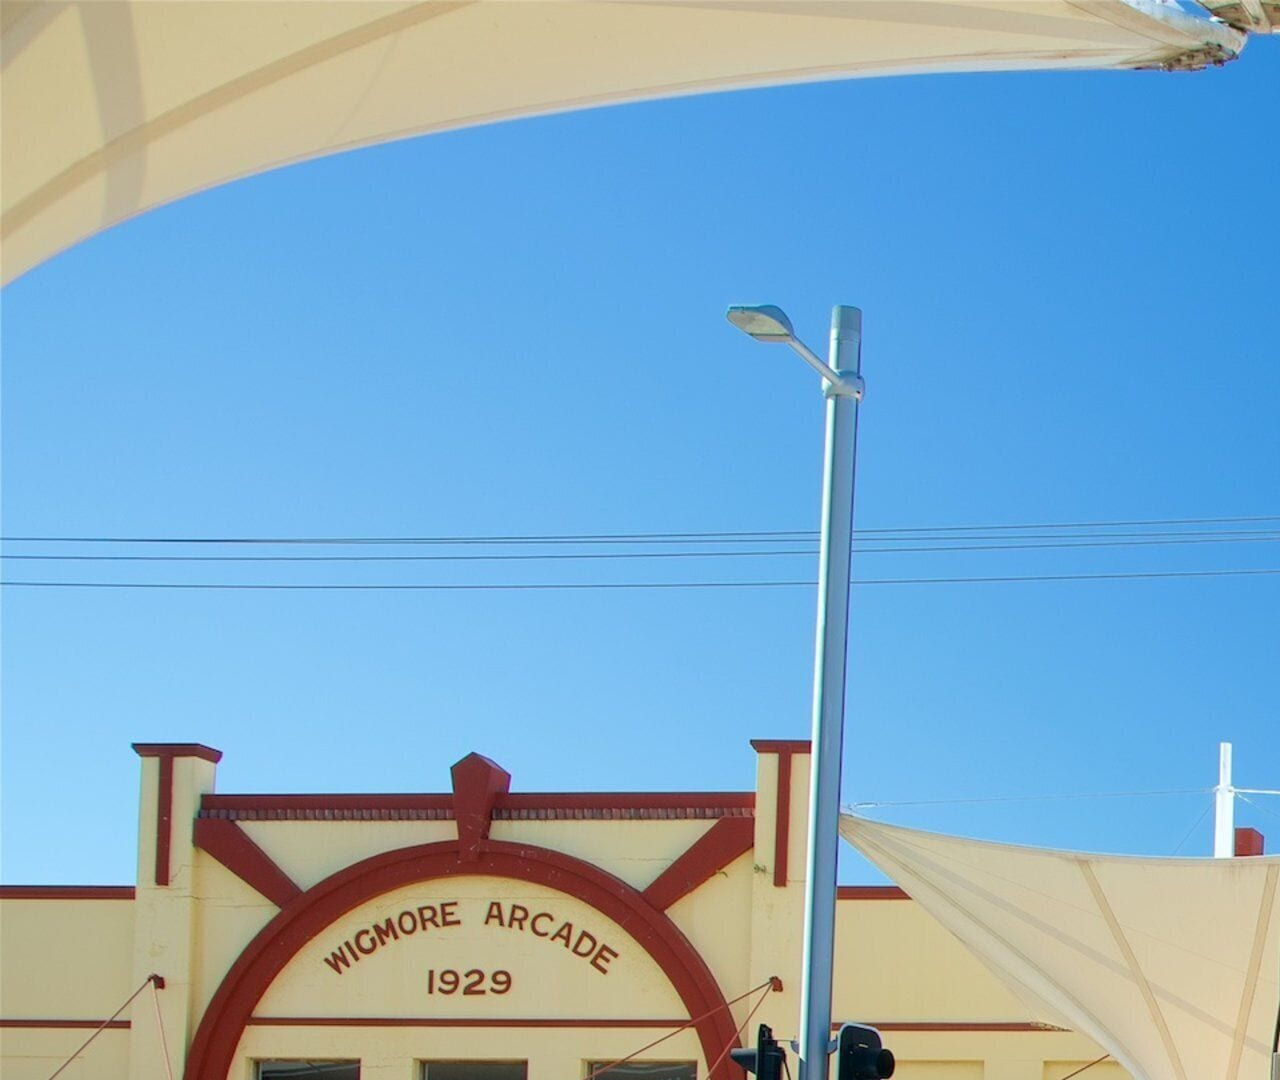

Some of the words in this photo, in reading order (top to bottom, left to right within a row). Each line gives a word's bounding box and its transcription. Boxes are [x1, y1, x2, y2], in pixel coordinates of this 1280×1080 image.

[323, 901, 461, 975] WIGMORE
[485, 901, 619, 975] ARCADE
[427, 968, 512, 995] 1929
